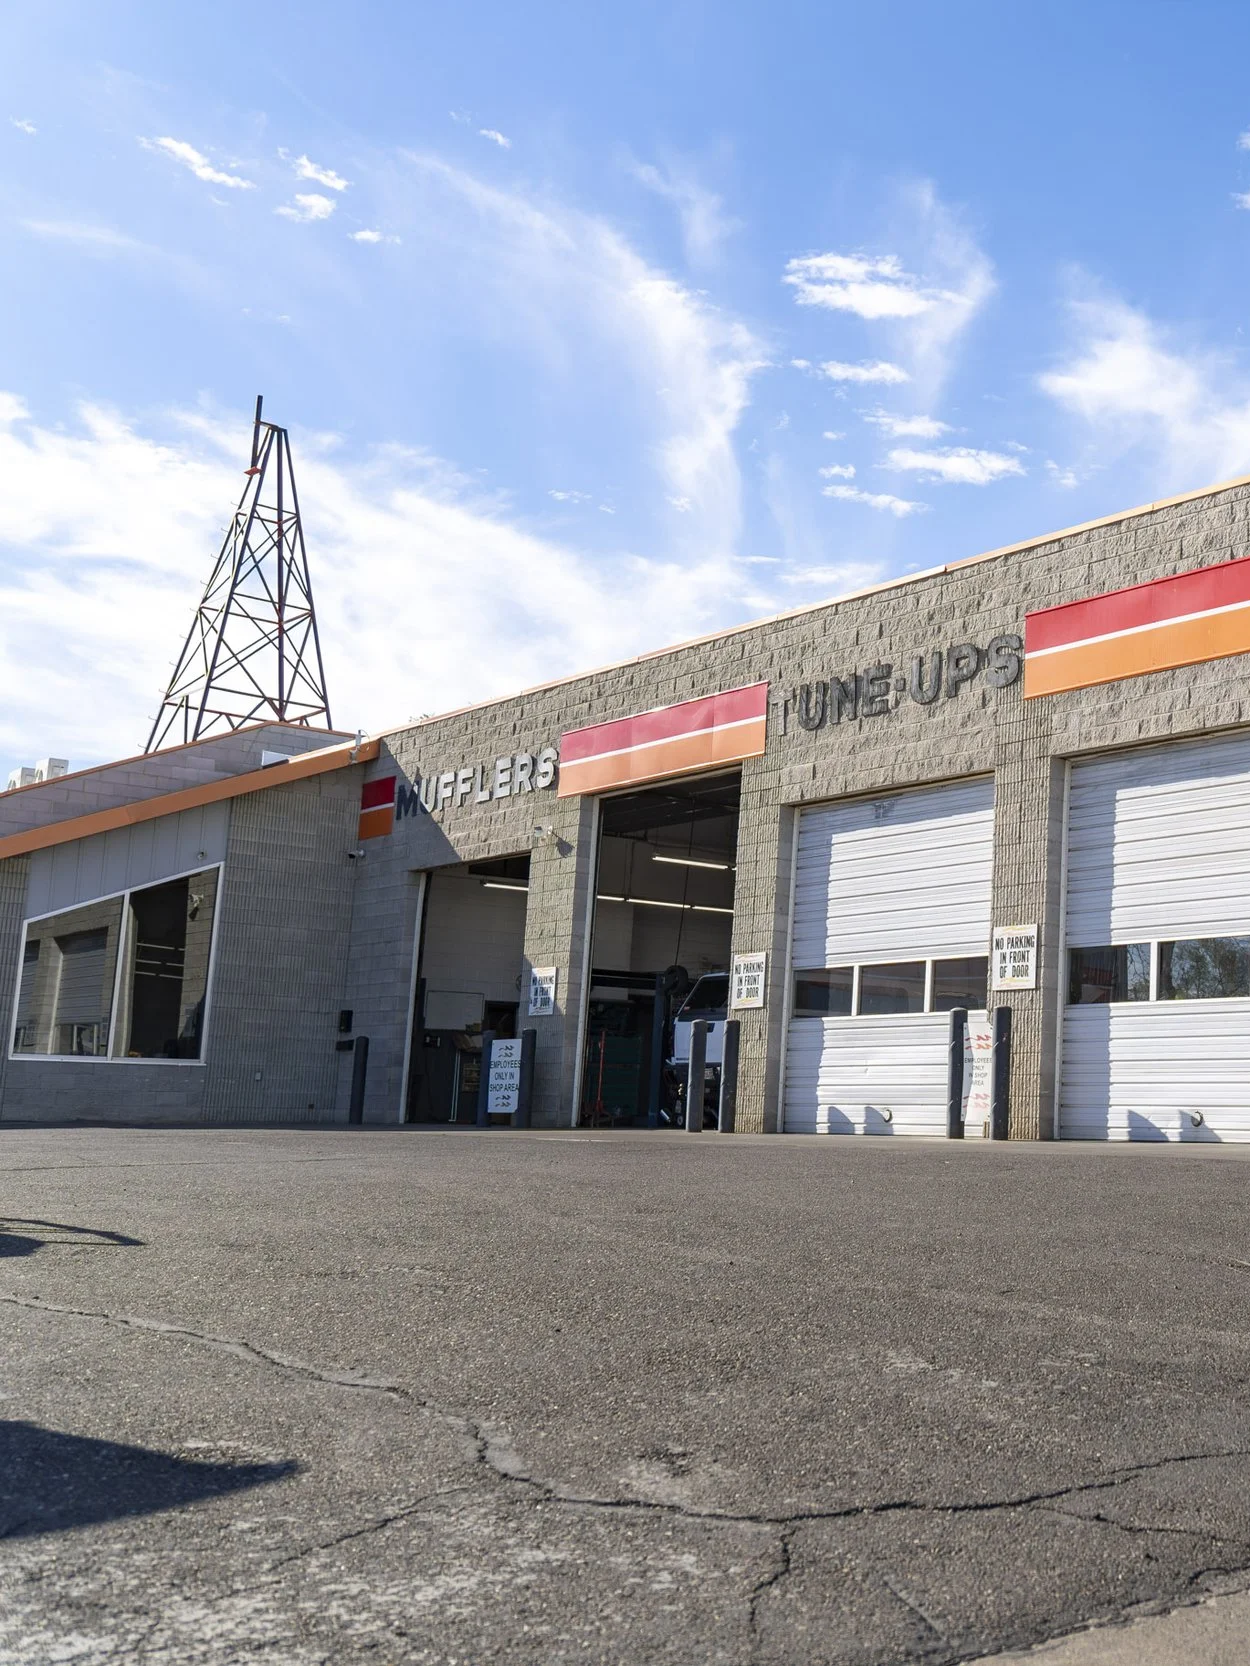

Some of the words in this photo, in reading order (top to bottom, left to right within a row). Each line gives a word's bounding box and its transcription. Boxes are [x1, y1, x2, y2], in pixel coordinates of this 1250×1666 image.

[395, 747, 560, 822] MUFFLERS
[995, 937, 1005, 951] NO
[1006, 935, 1035, 950] PARKING
[1000, 951, 1007, 965] IN
[1009, 950, 1030, 964] FRONT
[734, 963, 742, 975] NO
[742, 961, 764, 974] PARKING
[1000, 965, 1008, 979] OF
[1011, 964, 1029, 978] DOOR
[737, 975, 743, 987] IN
[744, 974, 760, 987] FRONT
[736, 987, 743, 999] OF
[745, 986, 759, 998] DOOR
[490, 1060, 521, 1070] EMPLOYEES
[494, 1071, 507, 1081] ONLY
[508, 1071, 515, 1080] IN
[489, 1083, 504, 1093] SHOP
[503, 1083, 519, 1093] AREA
